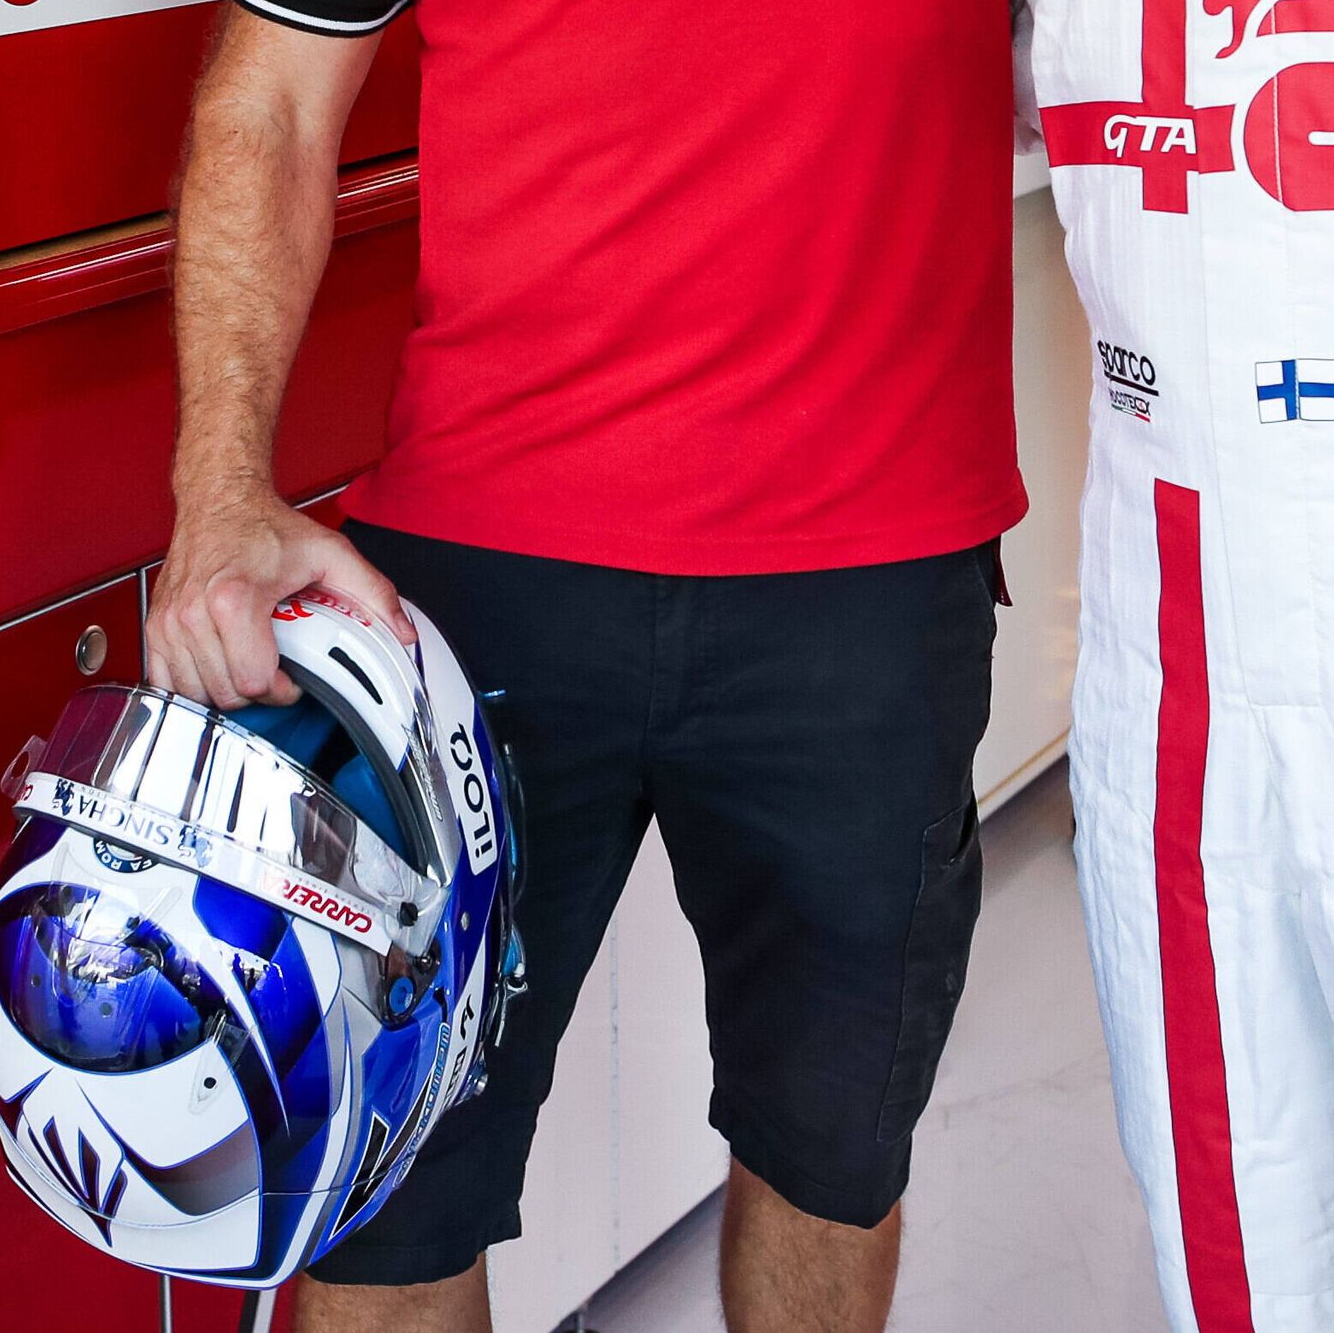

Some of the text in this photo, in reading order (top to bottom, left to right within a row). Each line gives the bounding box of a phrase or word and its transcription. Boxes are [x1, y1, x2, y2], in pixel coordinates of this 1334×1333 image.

[1103, 114, 1198, 158] GTA
[450, 722, 493, 859] iLOQ
[79, 795, 173, 846] SINGHA
[94, 840, 124, 870] ROM
